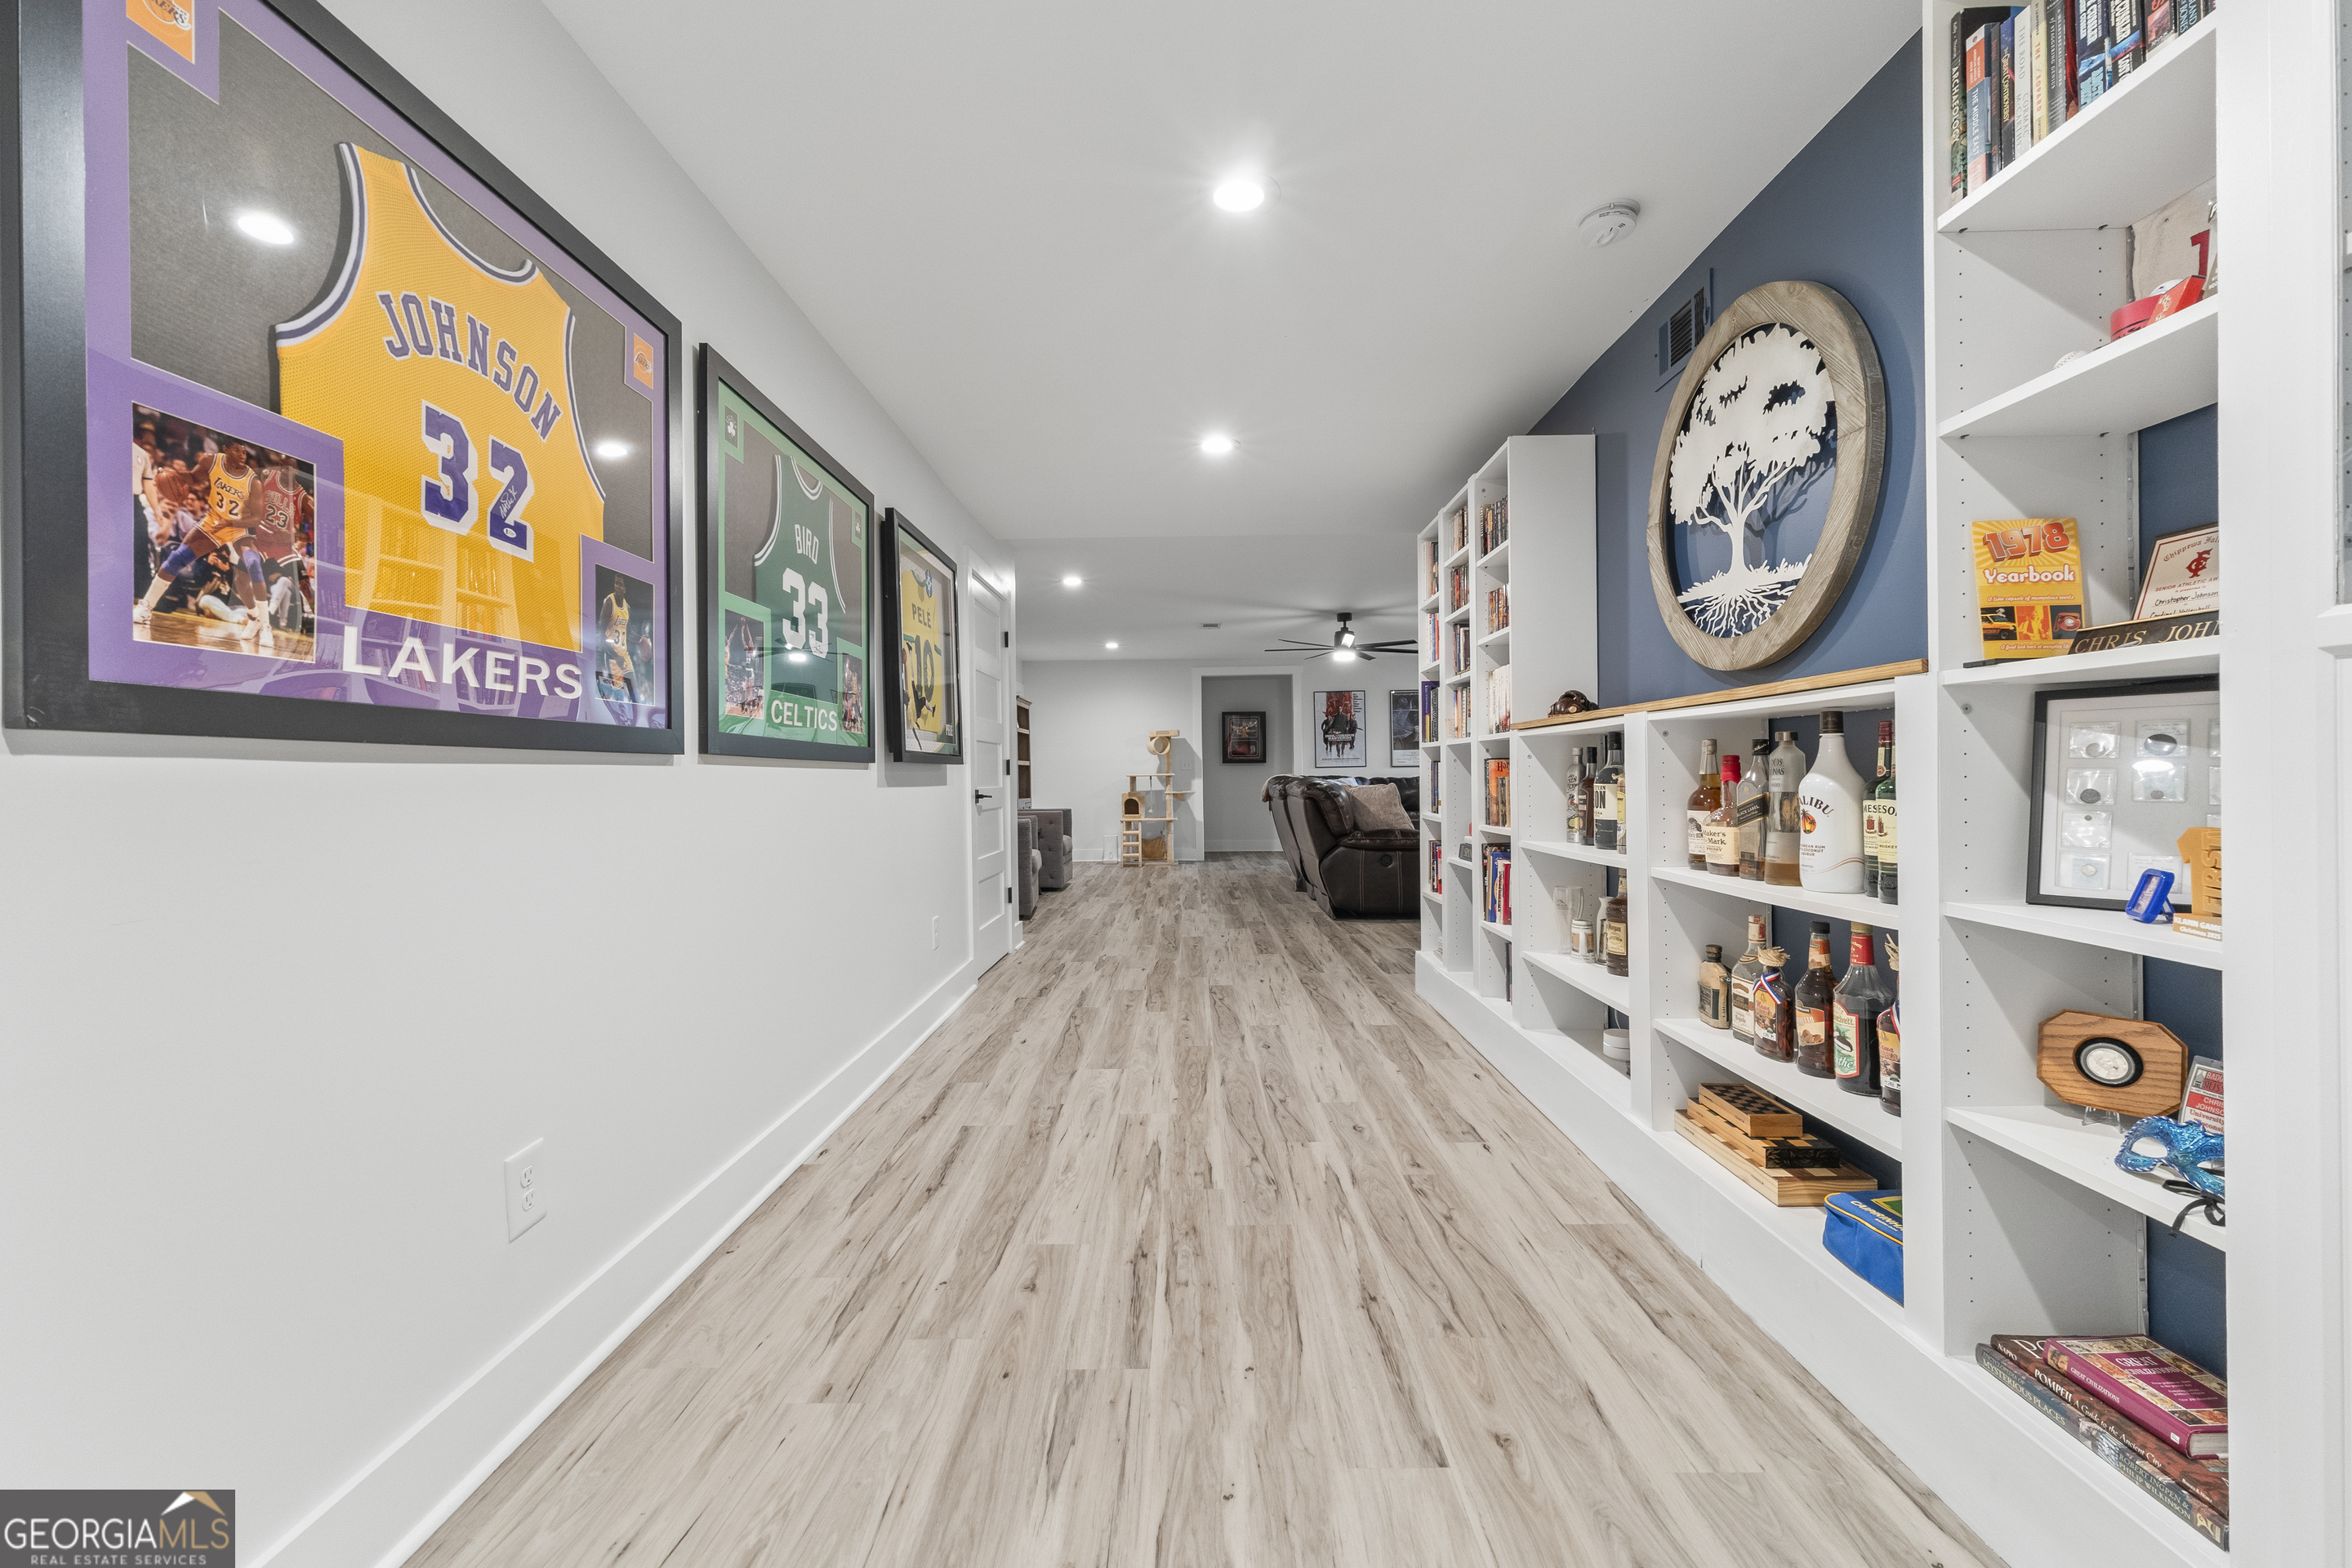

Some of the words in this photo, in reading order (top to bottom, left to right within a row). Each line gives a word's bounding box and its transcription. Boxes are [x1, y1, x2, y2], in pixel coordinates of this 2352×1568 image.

[2087, 3, 2098, 47] CUSSLER
[2115, 2, 2131, 44] CUSSLER
[2180, 4, 2189, 33] BONES
[2002, 53, 2011, 75] GREAT
[1952, 65, 1960, 145] ARCHAEOLOGY
[2002, 74, 2011, 122] CONTROVERSY
[375, 290, 564, 443] JOHNSON
[213, 476, 245, 501] LAKERS
[421, 399, 535, 564] 32
[216, 492, 243, 520] 32
[265, 490, 296, 519] BULLS
[265, 505, 289, 529] 23
[795, 523, 819, 565] BIRD
[1983, 522, 2071, 564] 1978
[2163, 541, 2202, 562] Chippewa
[1983, 564, 2075, 585] Yearbook
[2154, 584, 2176, 592] SENIOR
[2176, 578, 2207, 589] ATHLETIC
[2154, 595, 2190, 606] Christopher
[2191, 591, 2219, 600] Johnson
[782, 567, 828, 660] 33
[911, 603, 932, 629] PELÉ
[2074, 630, 2147, 654] CHRIS
[342, 626, 583, 700] LAKERS
[914, 635, 935, 703] 10
[771, 699, 838, 732] CELTICS
[1748, 804, 1760, 813] LABEL
[1878, 804, 1897, 816] ESO
[1708, 837, 1726, 846] Mark
[2174, 916, 2199, 928] KLANN
[2180, 926, 2207, 937] Christmas
[2203, 1097, 2225, 1108] CHRIS
[2194, 1117, 2224, 1134] Wsconsi
[1982, 1352, 2017, 1381] ENCYCLOPEDIA
[2115, 1356, 2158, 1367] GREAT
[2125, 1366, 2180, 1375] CIVILIZATIONS
[1983, 1358, 2032, 1401] MYSTERIOUS
[2033, 1396, 2065, 1426] PLACES
[2070, 1367, 2086, 1380] GREAT
[2086, 1377, 2120, 1403] CIVILIZATIONS
[1998, 1343, 2017, 1361] NAPPO
[2034, 1369, 2073, 1402] POMPEII
[2074, 1400, 2081, 1409] A
[2081, 1405, 2100, 1423] Guide
[2100, 1420, 2107, 1428] to
[2108, 1424, 2118, 1437] the
[2119, 1433, 2145, 1456] Ancient
[2145, 1452, 2163, 1468] City
[2118, 1453, 2149, 1478] ROBERT
[2149, 1475, 2181, 1503] INGPEN
[2182, 1499, 2189, 1508] &
[2118, 1461, 2144, 1486] PHILIP
[2145, 1481, 2191, 1520] WILKINSON
